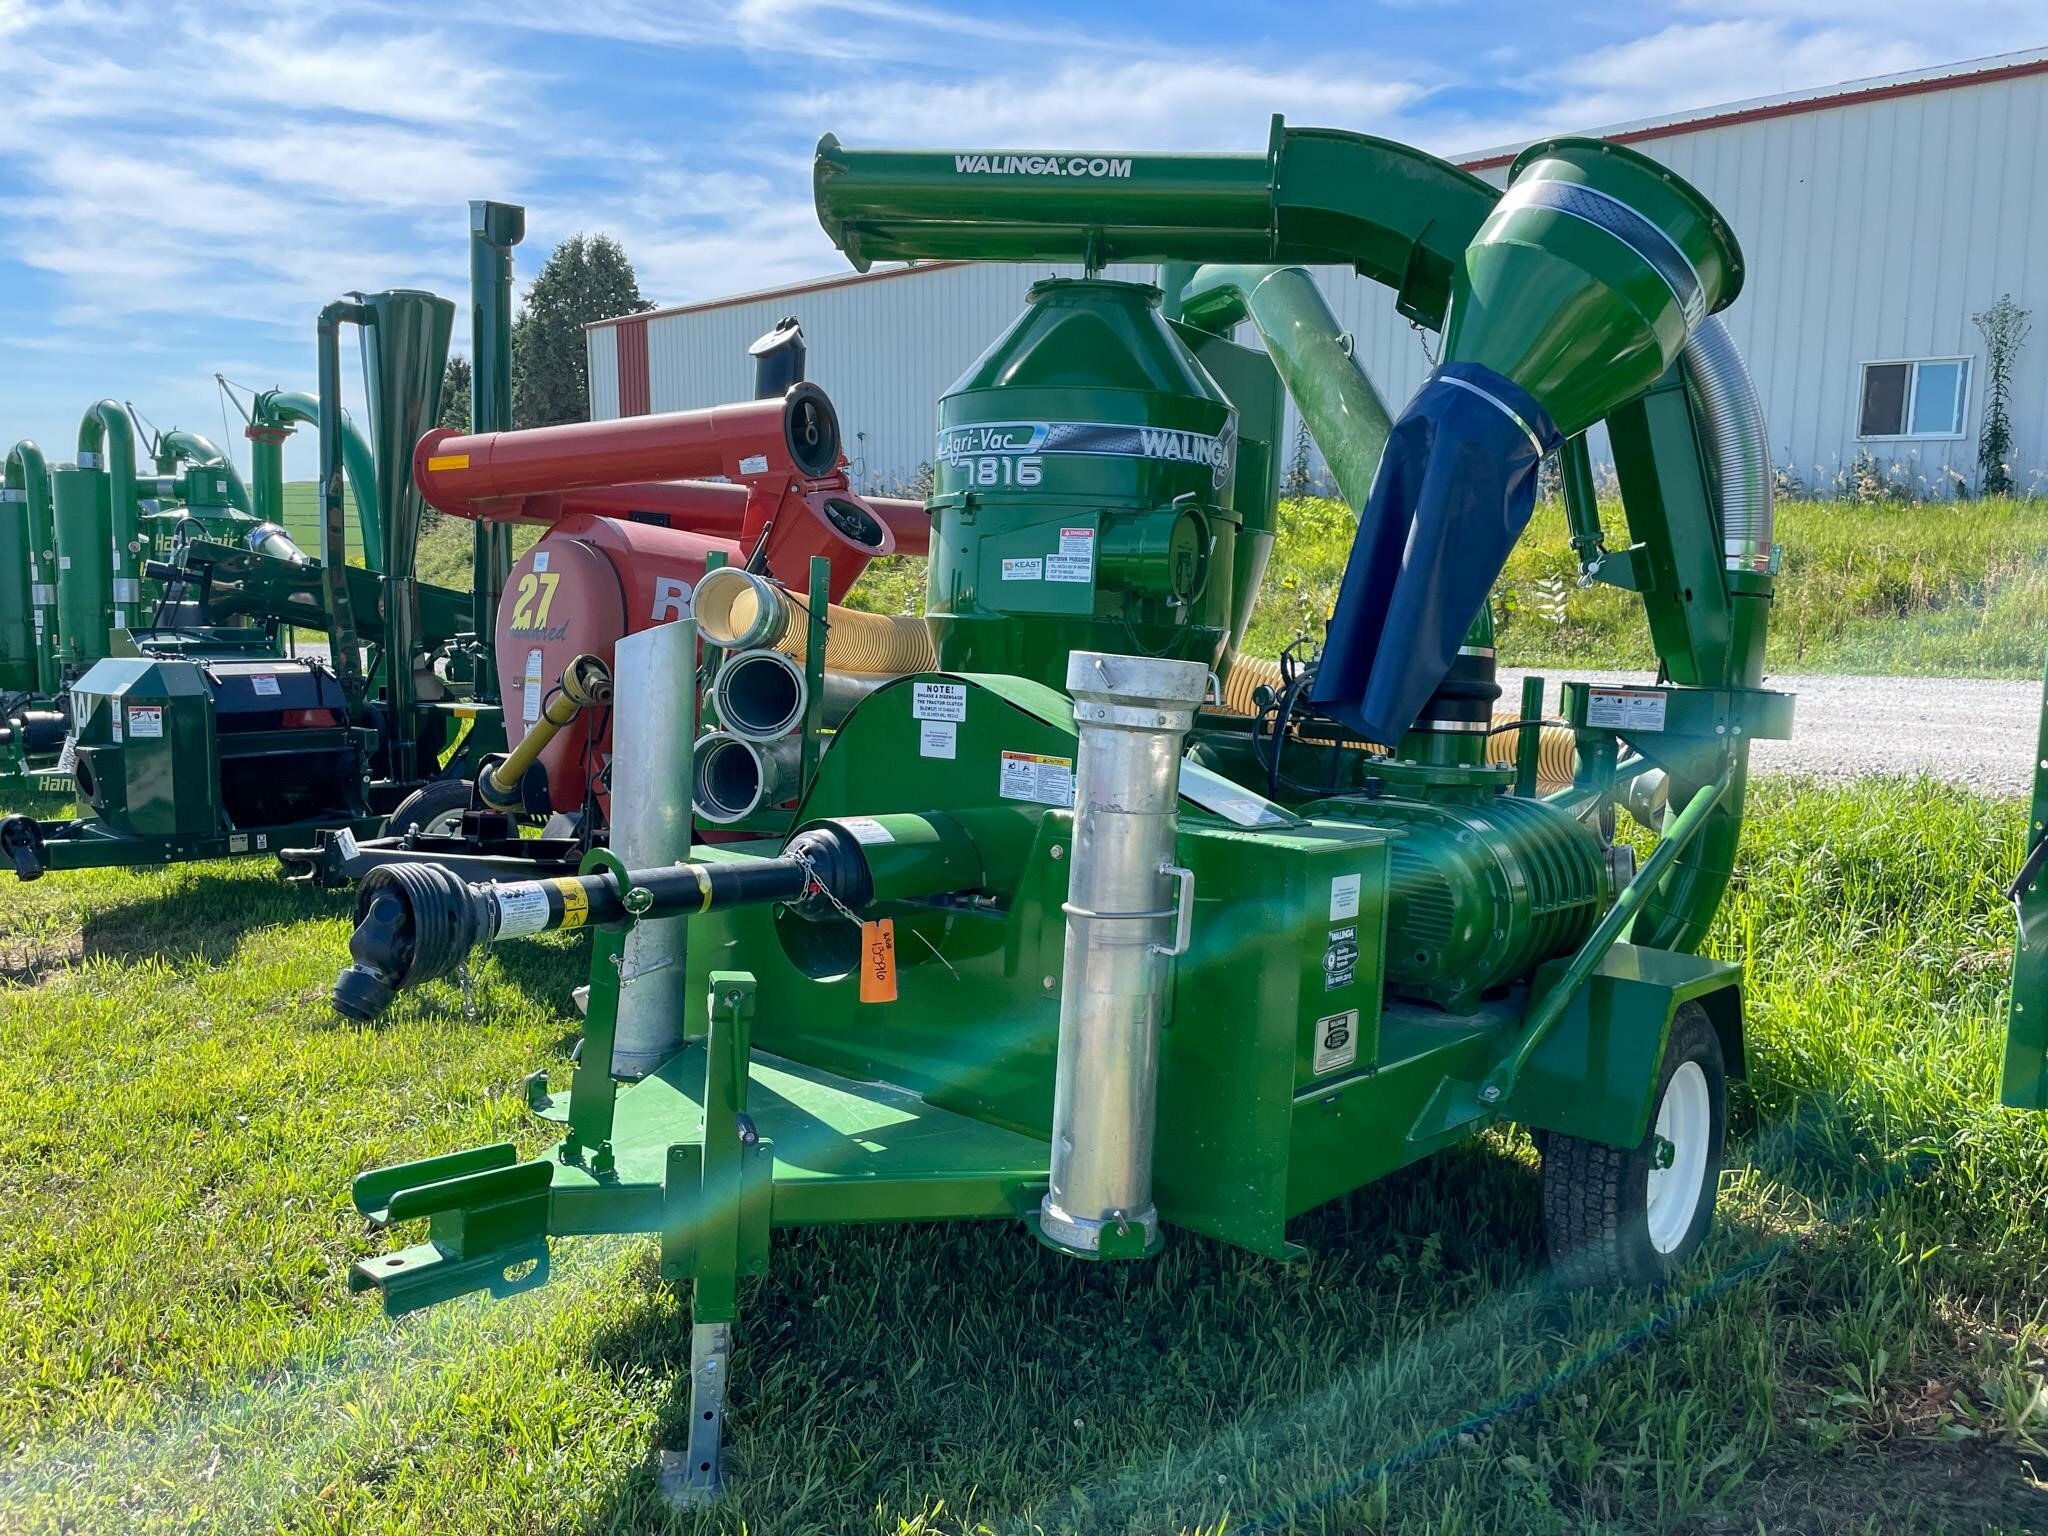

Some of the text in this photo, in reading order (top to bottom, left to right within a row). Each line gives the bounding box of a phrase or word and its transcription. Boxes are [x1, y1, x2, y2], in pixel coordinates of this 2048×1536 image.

[945, 428, 1014, 467] Agri-Vac
[1141, 429, 1231, 468] WALINGA
[957, 457, 1043, 487] 7816
[510, 573, 560, 630] 27
[926, 685, 954, 694] NOTE!
